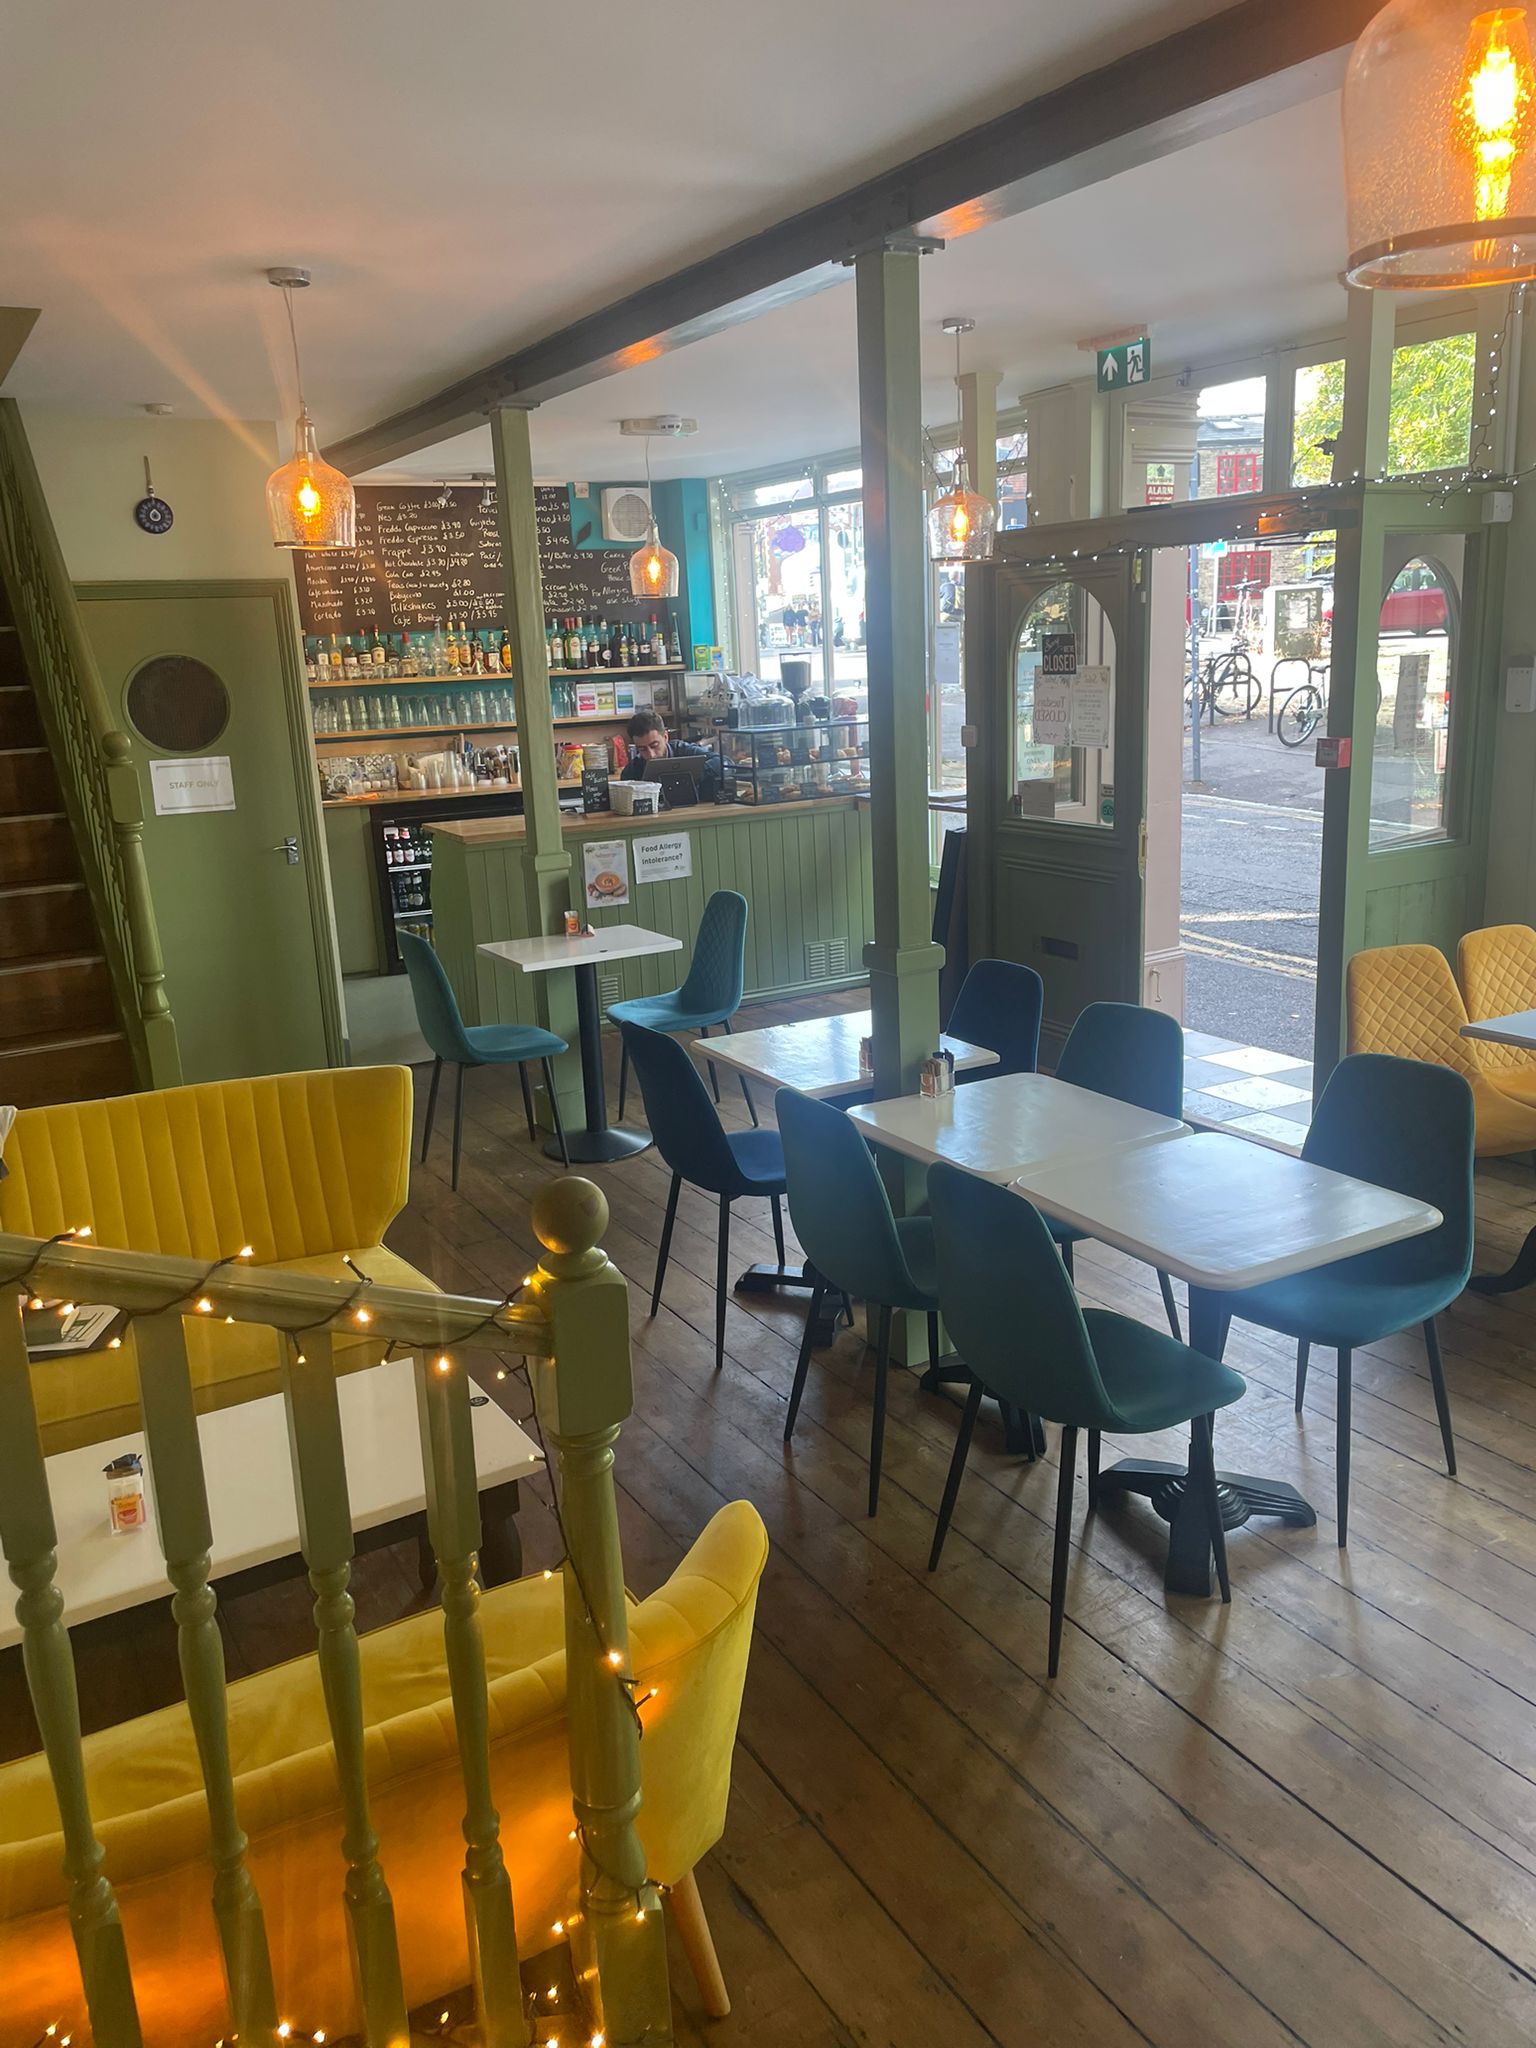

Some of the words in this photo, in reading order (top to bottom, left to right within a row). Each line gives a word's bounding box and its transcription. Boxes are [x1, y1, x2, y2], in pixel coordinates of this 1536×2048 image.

[1147, 486, 1174, 495] ALARM
[378, 524, 402, 534] Freddo
[379, 535, 405, 545] Freddo
[390, 602, 437, 614] Milkshakes
[1043, 654, 1076, 672] CLOSED
[168, 781, 195, 790] STAFF
[196, 780, 219, 788] ONLY
[640, 845, 659, 854] Food
[658, 842, 682, 851] Allergy
[641, 853, 683, 866] Intolerance?
